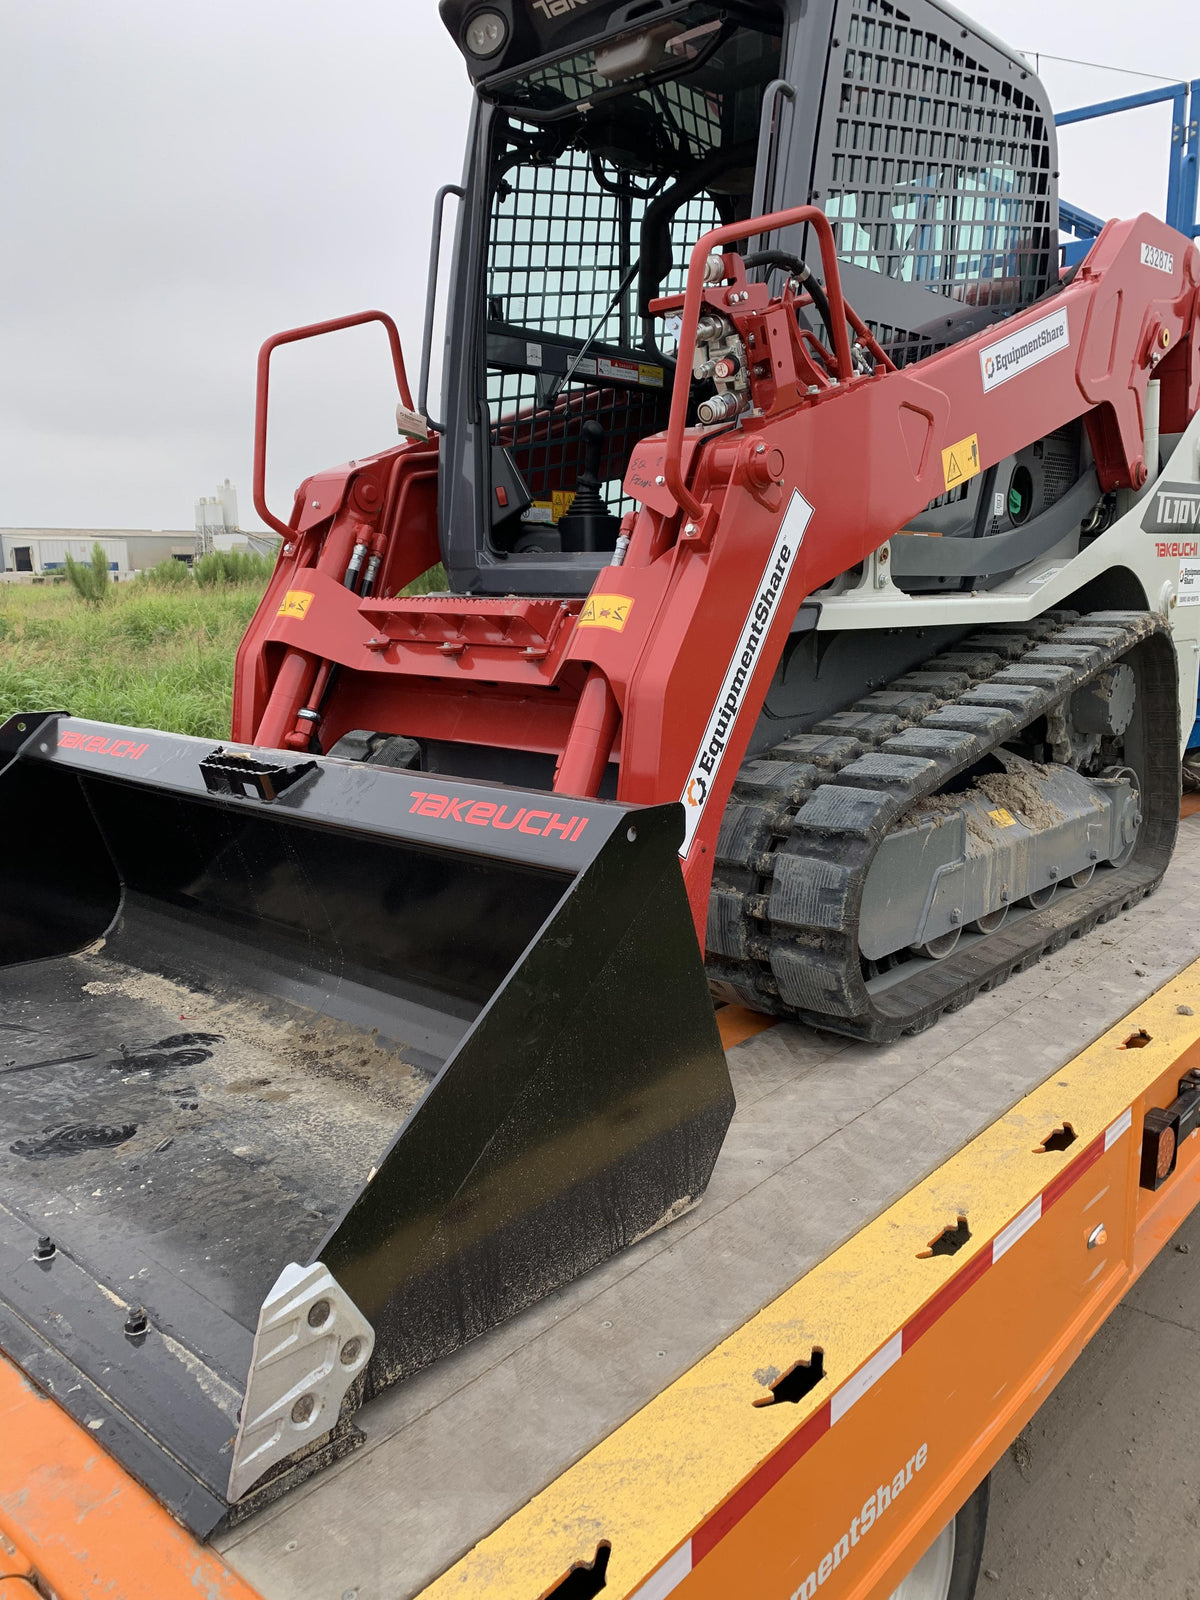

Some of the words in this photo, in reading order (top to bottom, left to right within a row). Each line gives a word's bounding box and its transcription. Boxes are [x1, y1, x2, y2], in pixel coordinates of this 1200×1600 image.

[1144, 245, 1173, 272] 232875
[995, 325, 1065, 371] EquipmentShare
[1157, 491, 1200, 524] TL10V
[698, 543, 792, 777] EquipmentShare
